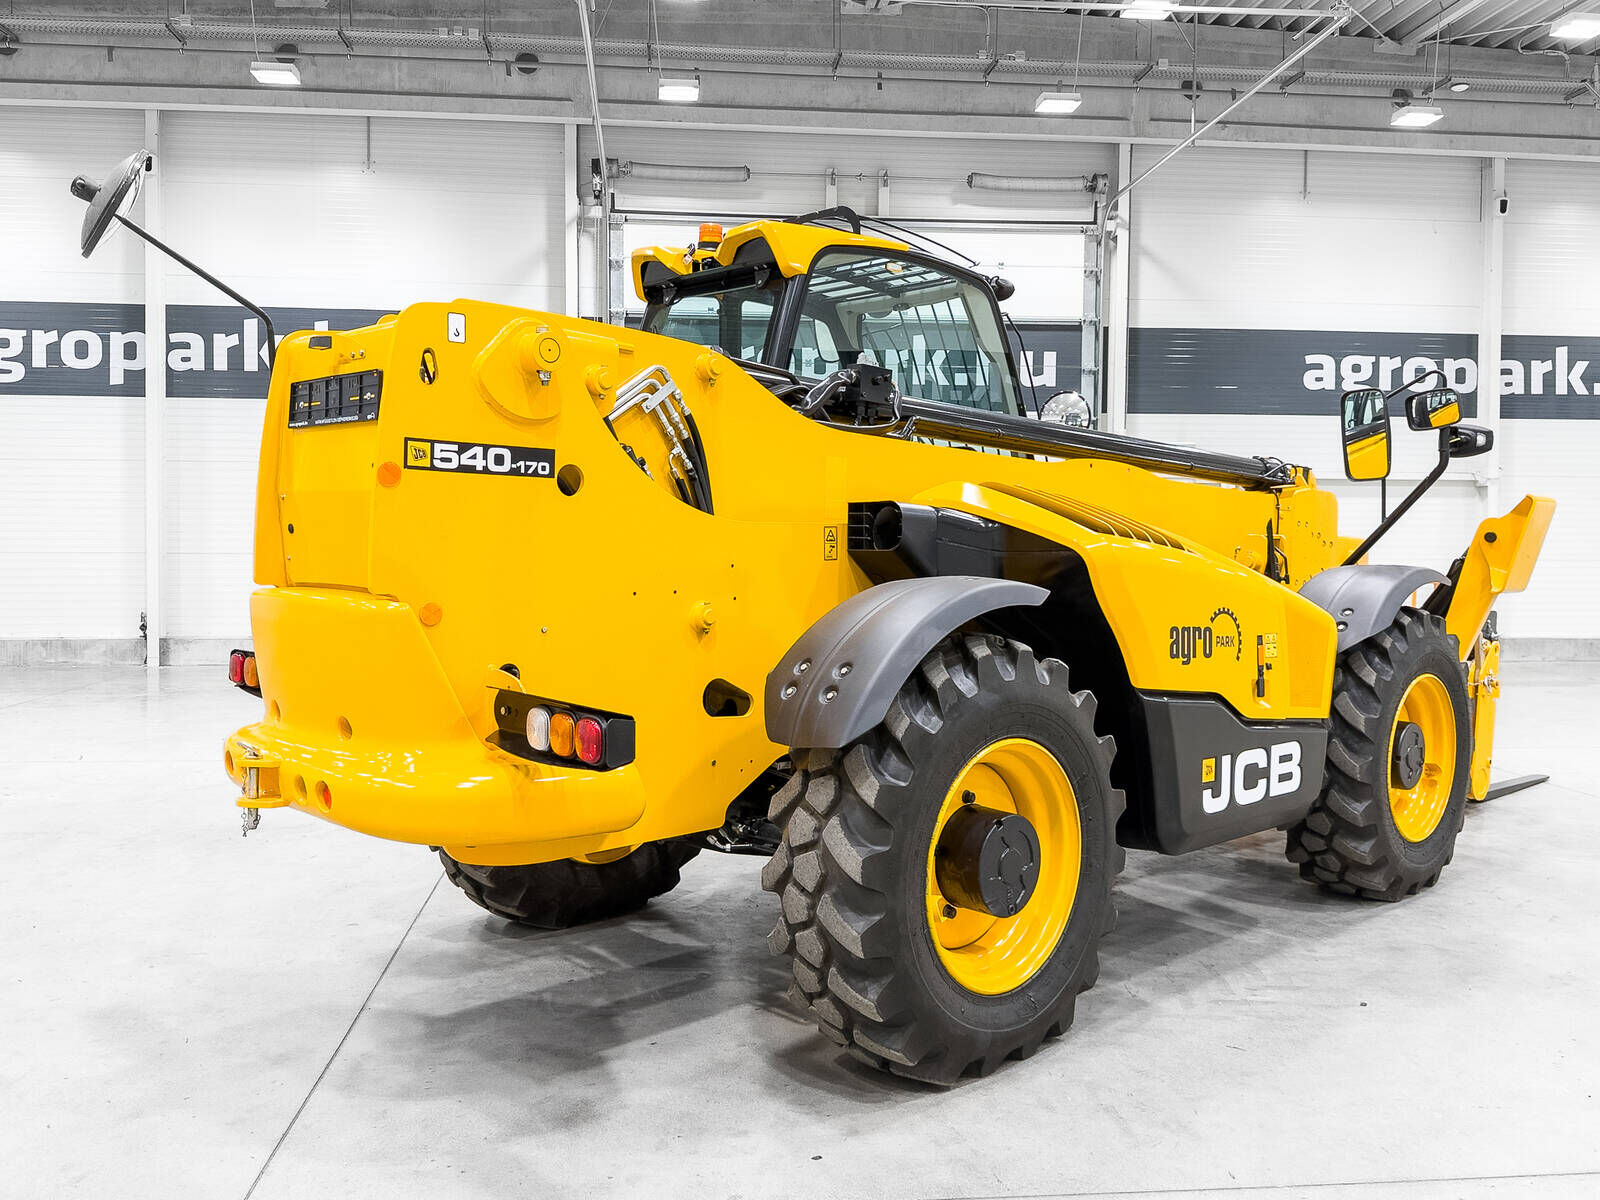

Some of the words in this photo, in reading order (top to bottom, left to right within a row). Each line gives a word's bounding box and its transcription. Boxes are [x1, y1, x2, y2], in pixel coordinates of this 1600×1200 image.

[412, 446, 427, 460] JCB
[433, 442, 550, 475] 540-170
[1170, 626, 1212, 665] agro
[1216, 636, 1235, 647] PARK
[1203, 741, 1301, 814] JCB
